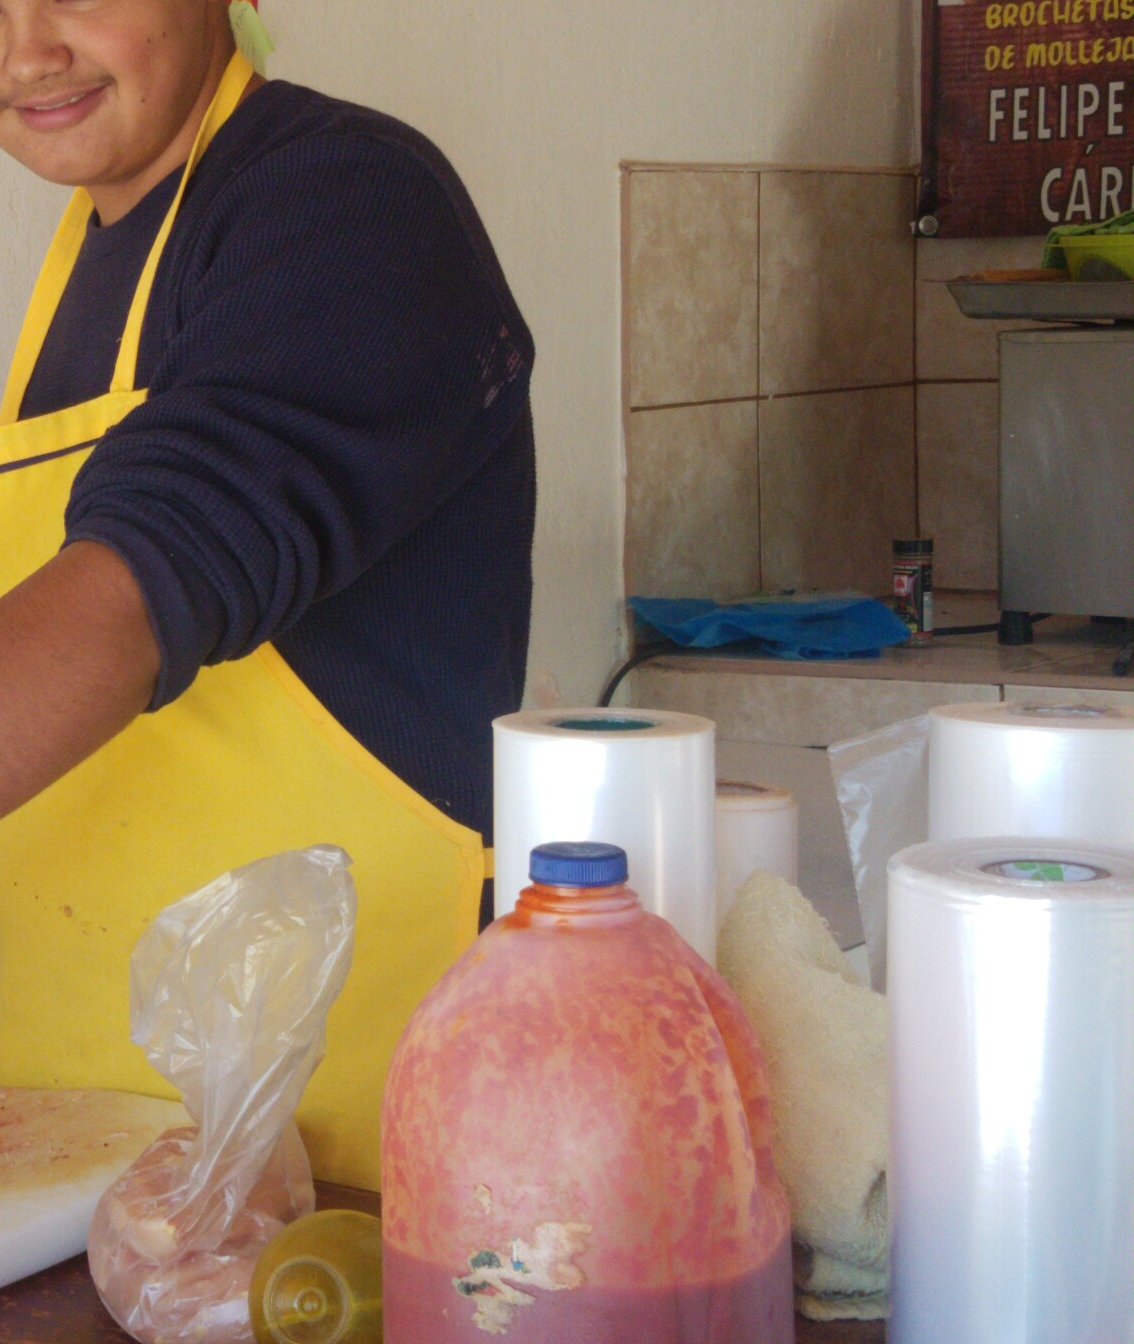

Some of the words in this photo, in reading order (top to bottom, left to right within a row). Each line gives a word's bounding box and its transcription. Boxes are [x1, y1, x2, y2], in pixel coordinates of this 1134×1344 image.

[984, 43, 1016, 72] DE
[988, 80, 1125, 143] FELIPE
[1039, 143, 1134, 224] CÁR
